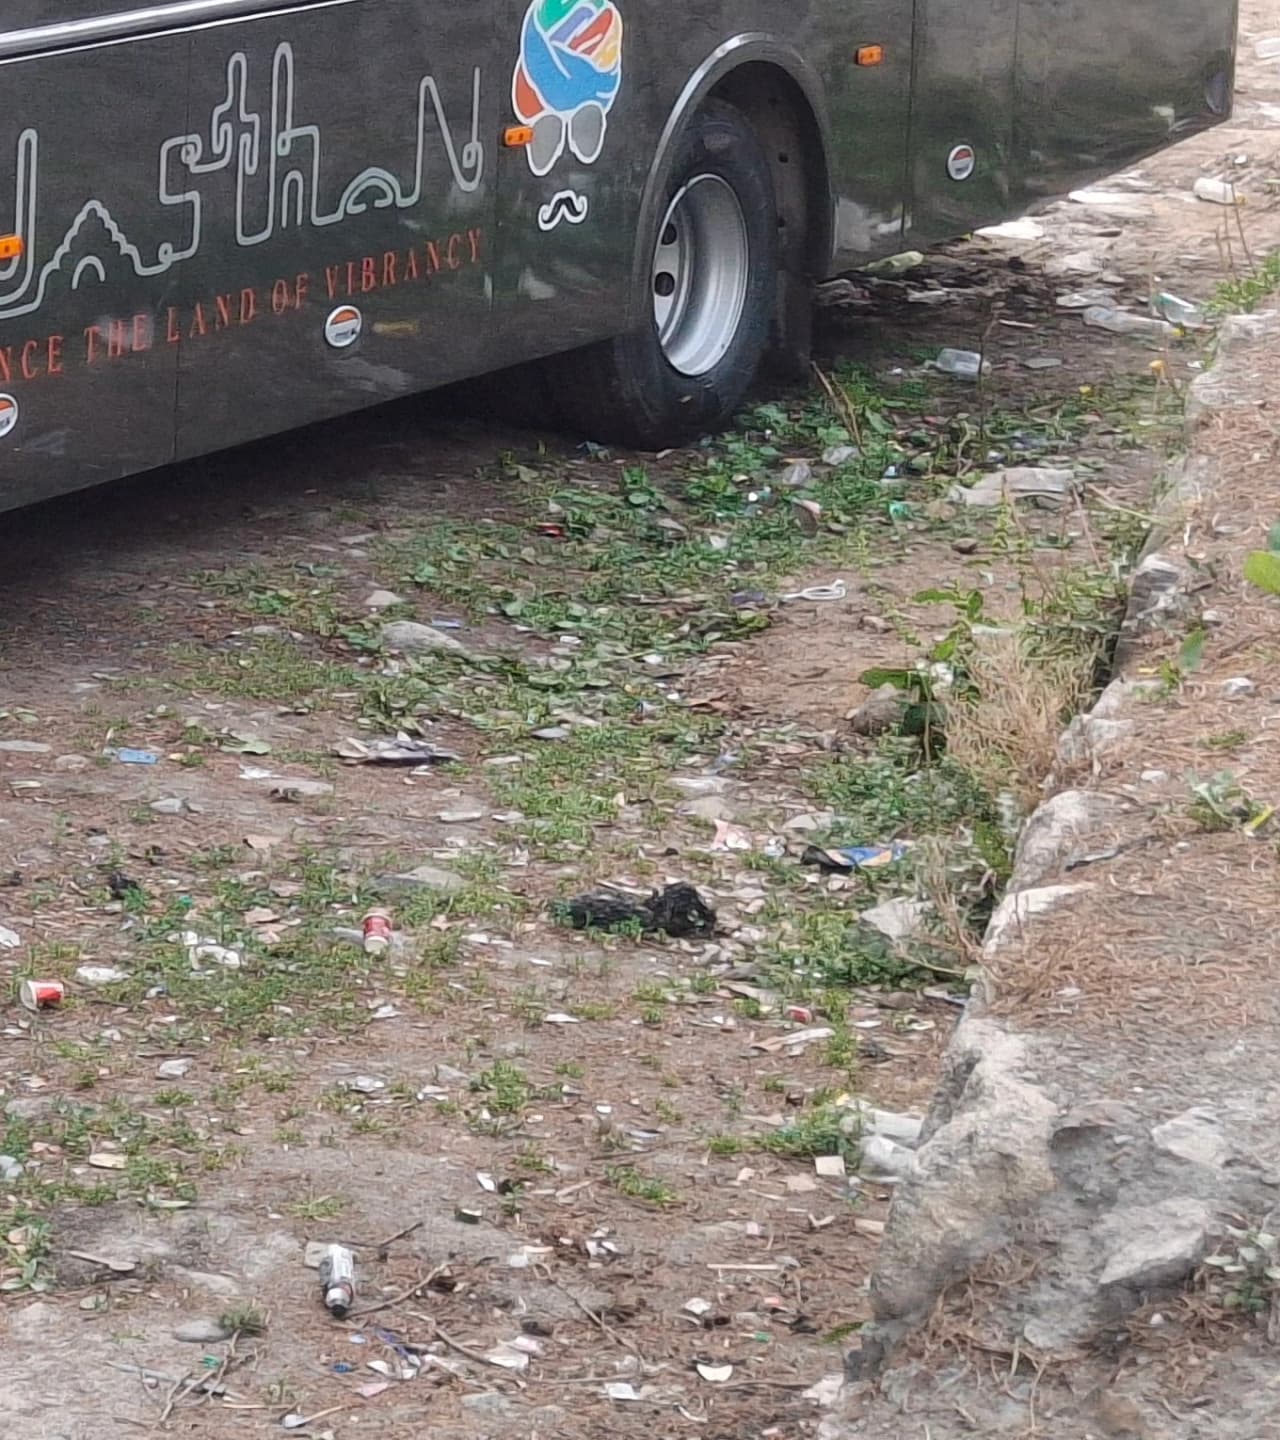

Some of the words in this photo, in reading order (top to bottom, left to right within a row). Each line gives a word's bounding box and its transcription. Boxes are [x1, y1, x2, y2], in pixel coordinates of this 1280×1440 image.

[84, 313, 152, 362] THE
[166, 287, 258, 344] LAND
[271, 272, 309, 314] OF
[325, 227, 482, 300] VIBRANCY
